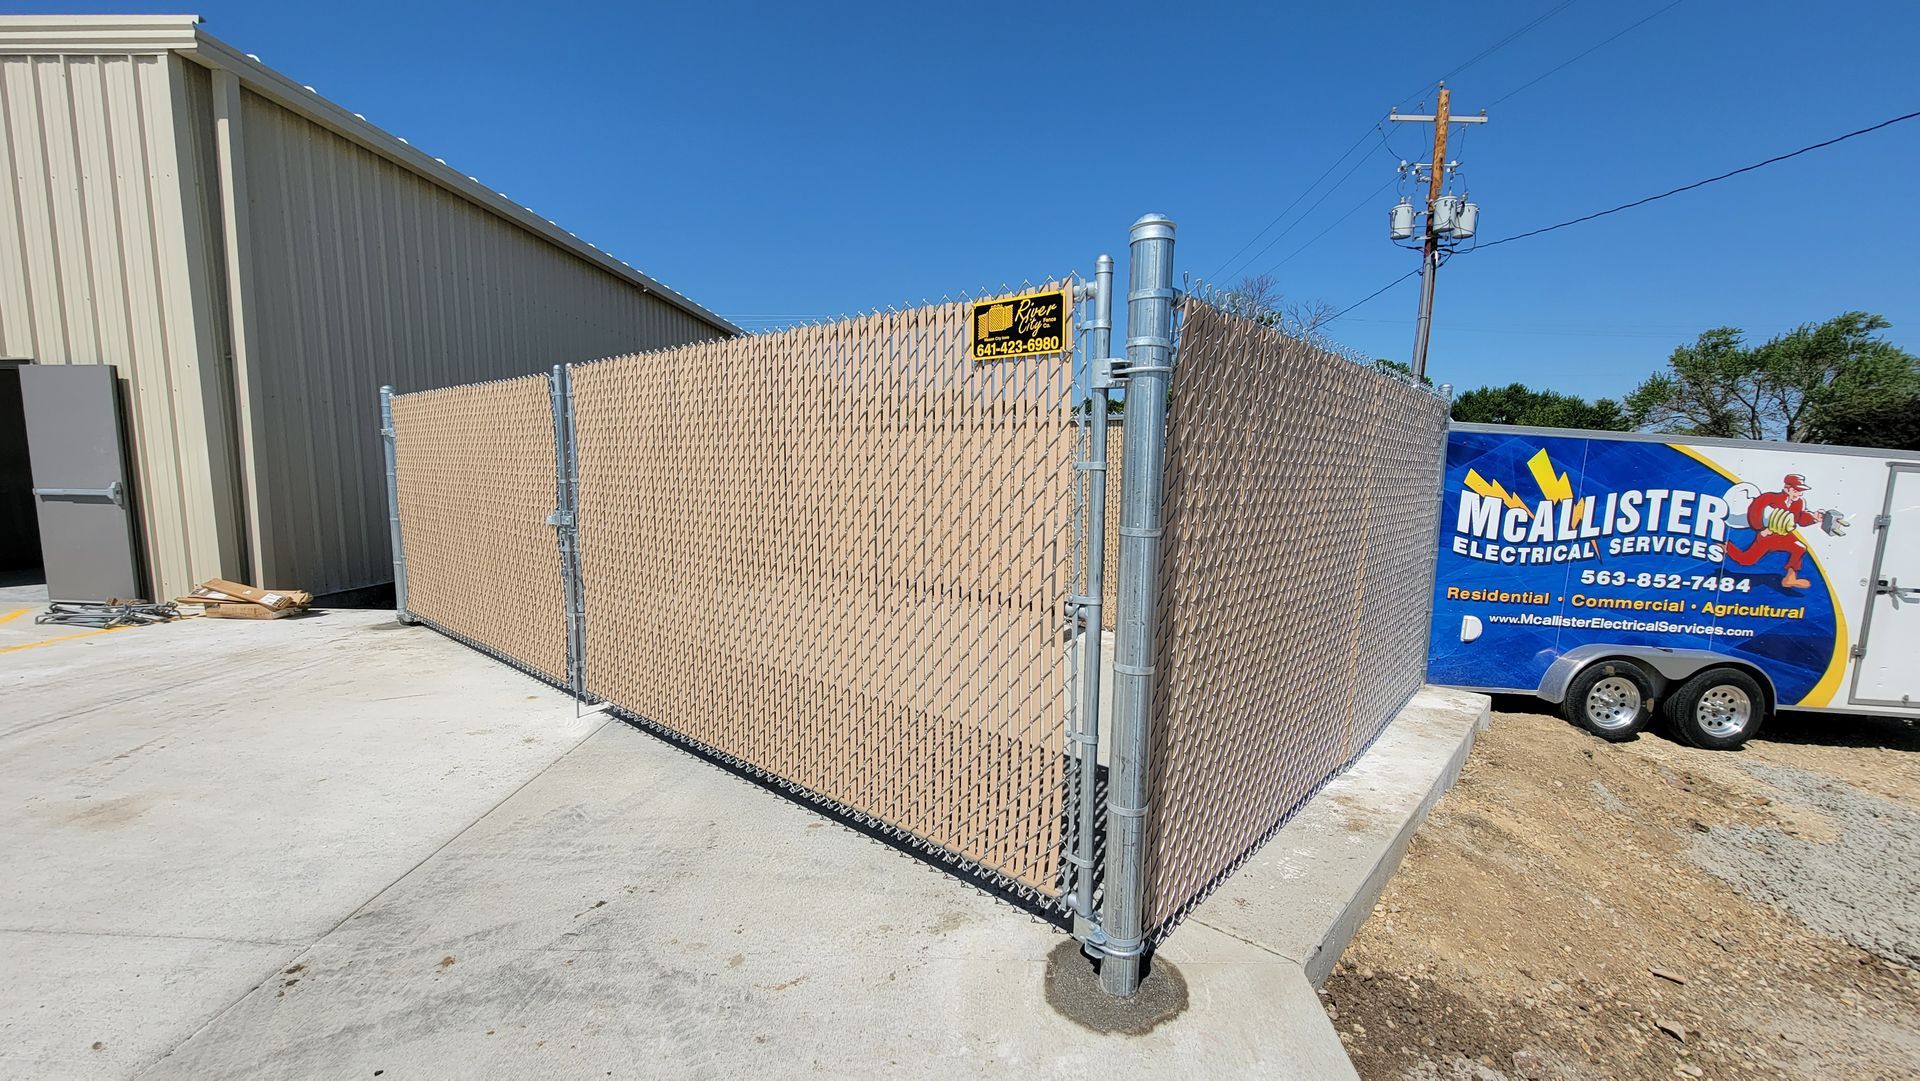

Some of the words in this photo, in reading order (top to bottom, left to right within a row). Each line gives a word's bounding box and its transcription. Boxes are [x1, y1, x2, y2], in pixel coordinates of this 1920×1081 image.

[1014, 299, 1057, 322] River
[1018, 318, 1042, 337] City
[977, 336, 1059, 356] 641-423-6980
[1453, 535, 1595, 564] ELECTRICAL
[1608, 536, 1725, 563] SERVICES
[1581, 570, 1751, 593] 563-852-7484
[1447, 586, 1549, 605] Residential
[1571, 594, 1685, 612] Commercial
[1702, 601, 1805, 619] Agricultural
[1489, 613, 1754, 637] www.McallisterElectricalServices.com
